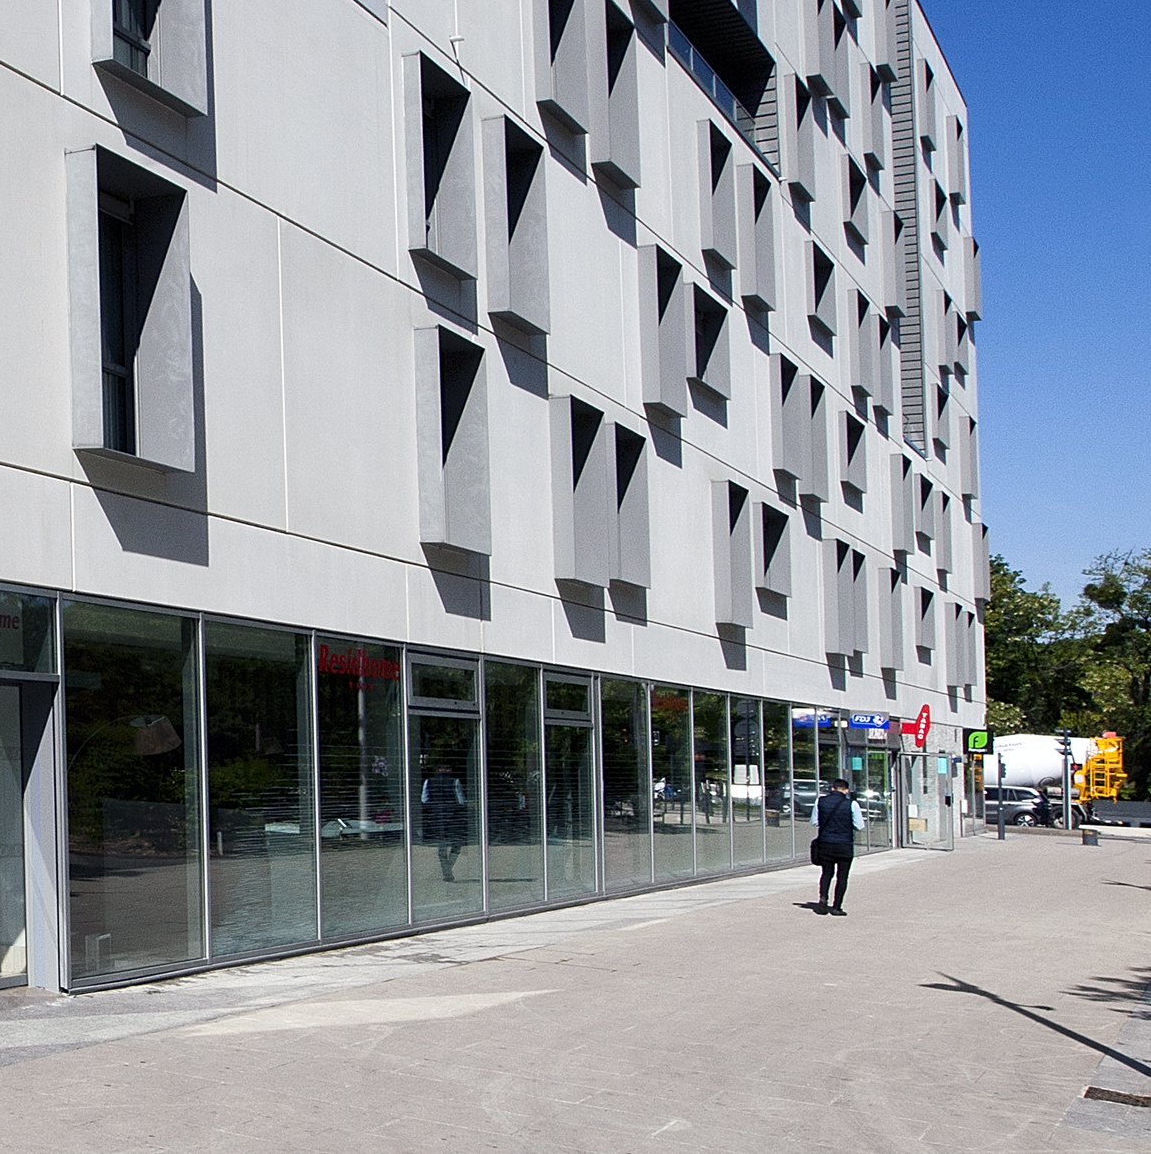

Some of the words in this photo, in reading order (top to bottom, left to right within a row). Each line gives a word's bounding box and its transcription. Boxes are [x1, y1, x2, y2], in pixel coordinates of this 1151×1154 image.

[319, 644, 400, 680] Residhome
[854, 715, 871, 723] FDJ
[917, 712, 928, 739] TABAC
